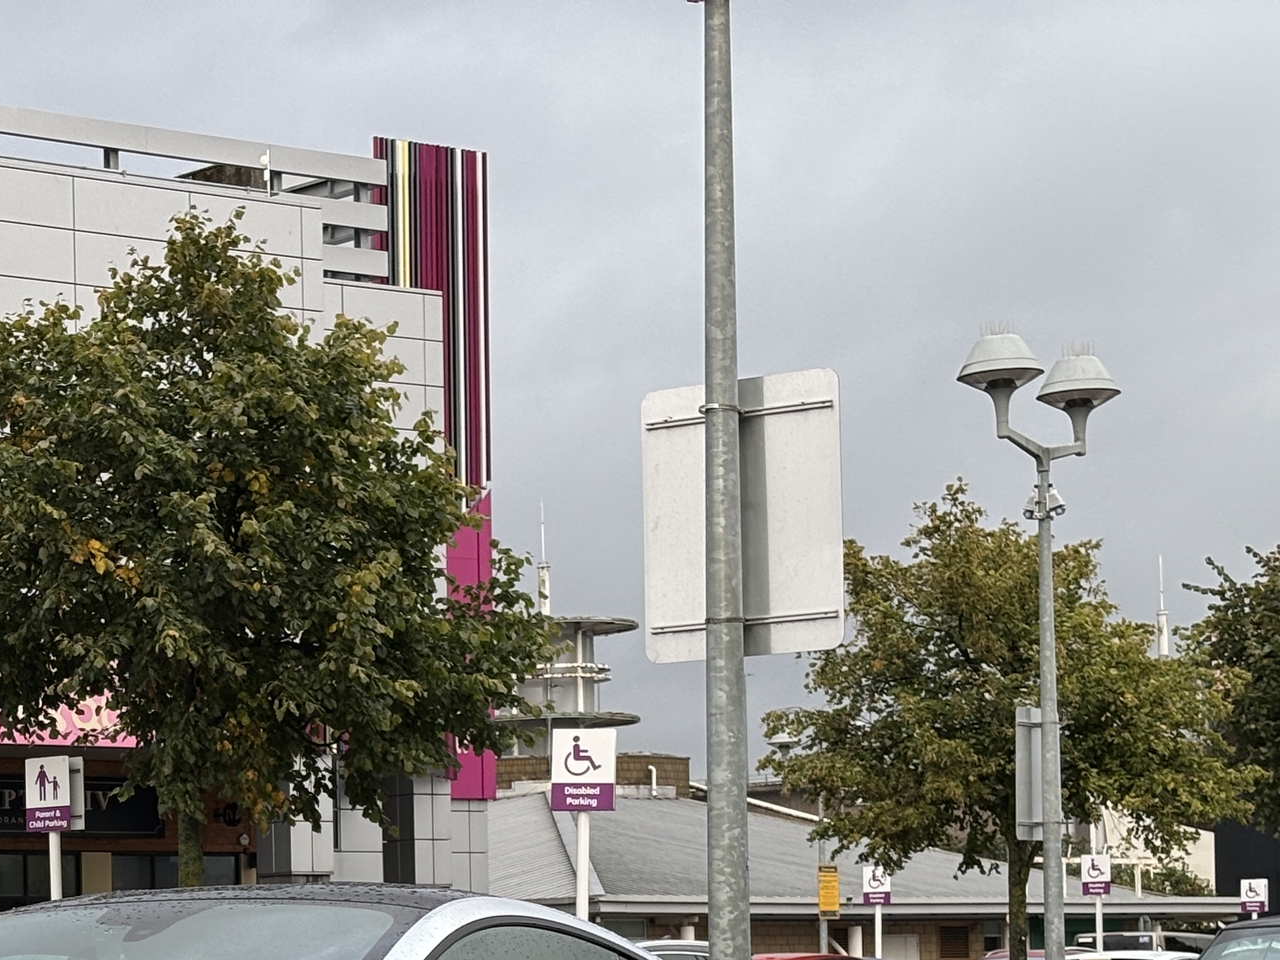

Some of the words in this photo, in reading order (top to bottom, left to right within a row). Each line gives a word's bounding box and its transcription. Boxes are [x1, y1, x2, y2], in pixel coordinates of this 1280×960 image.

[564, 786, 600, 795] Disabled
[566, 797, 598, 807] Parking
[35, 810, 55, 818] Parent
[55, 809, 61, 817] &
[29, 820, 44, 828] Child
[45, 819, 68, 828] Parking
